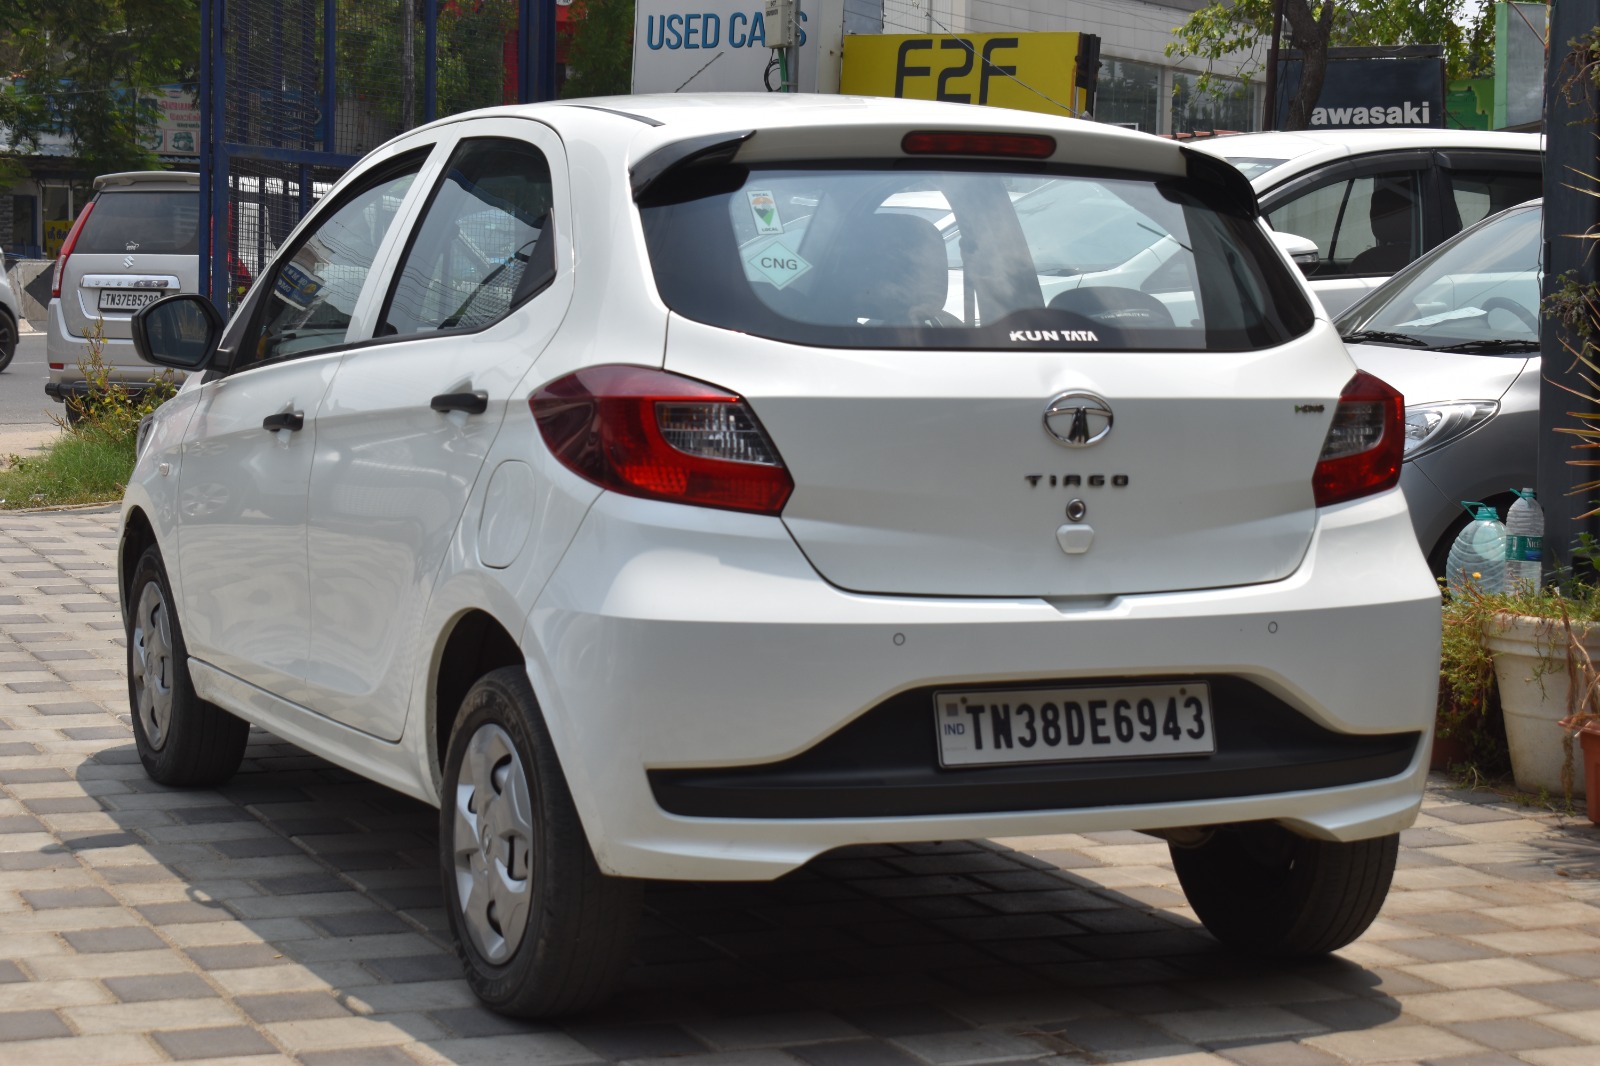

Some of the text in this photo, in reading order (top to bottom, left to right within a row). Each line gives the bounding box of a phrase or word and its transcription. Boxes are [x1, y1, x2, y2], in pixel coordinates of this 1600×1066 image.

[647, 11, 808, 51] USED CAS
[1309, 101, 1430, 126] awasaki
[760, 257, 798, 271] CNG
[1009, 330, 1099, 342] KUN TATA
[1024, 474, 1129, 488] TIAGO
[944, 723, 965, 735] IND
[964, 696, 1206, 751] TN38DE6943
